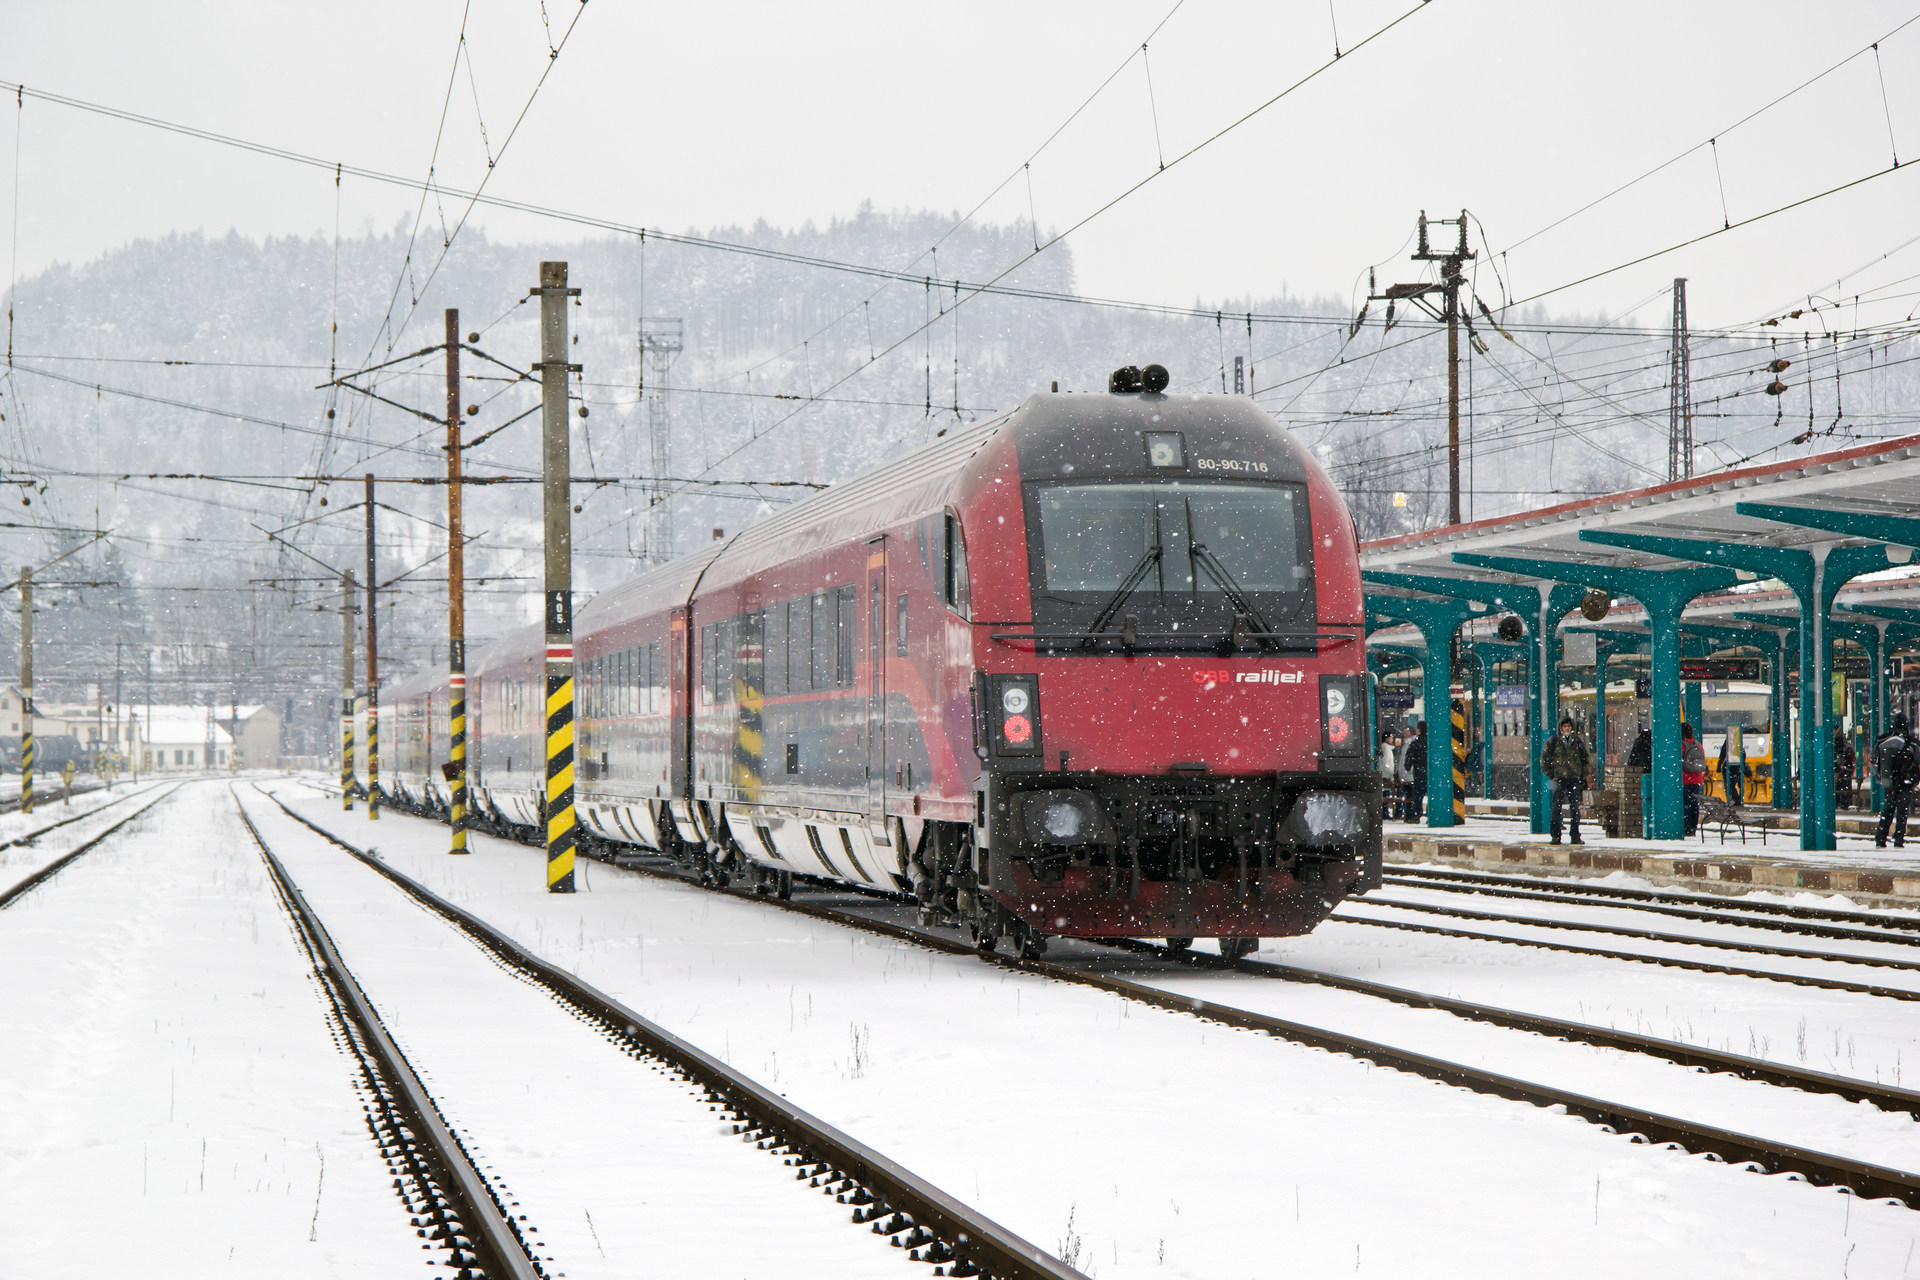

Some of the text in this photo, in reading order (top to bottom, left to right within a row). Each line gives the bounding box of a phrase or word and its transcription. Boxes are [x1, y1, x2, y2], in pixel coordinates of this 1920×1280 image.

[1197, 458, 1269, 473] 80-90.716
[555, 591, 564, 624] 405
[1235, 669, 1304, 686] railjet
[1150, 784, 1216, 796] SIEMENS
